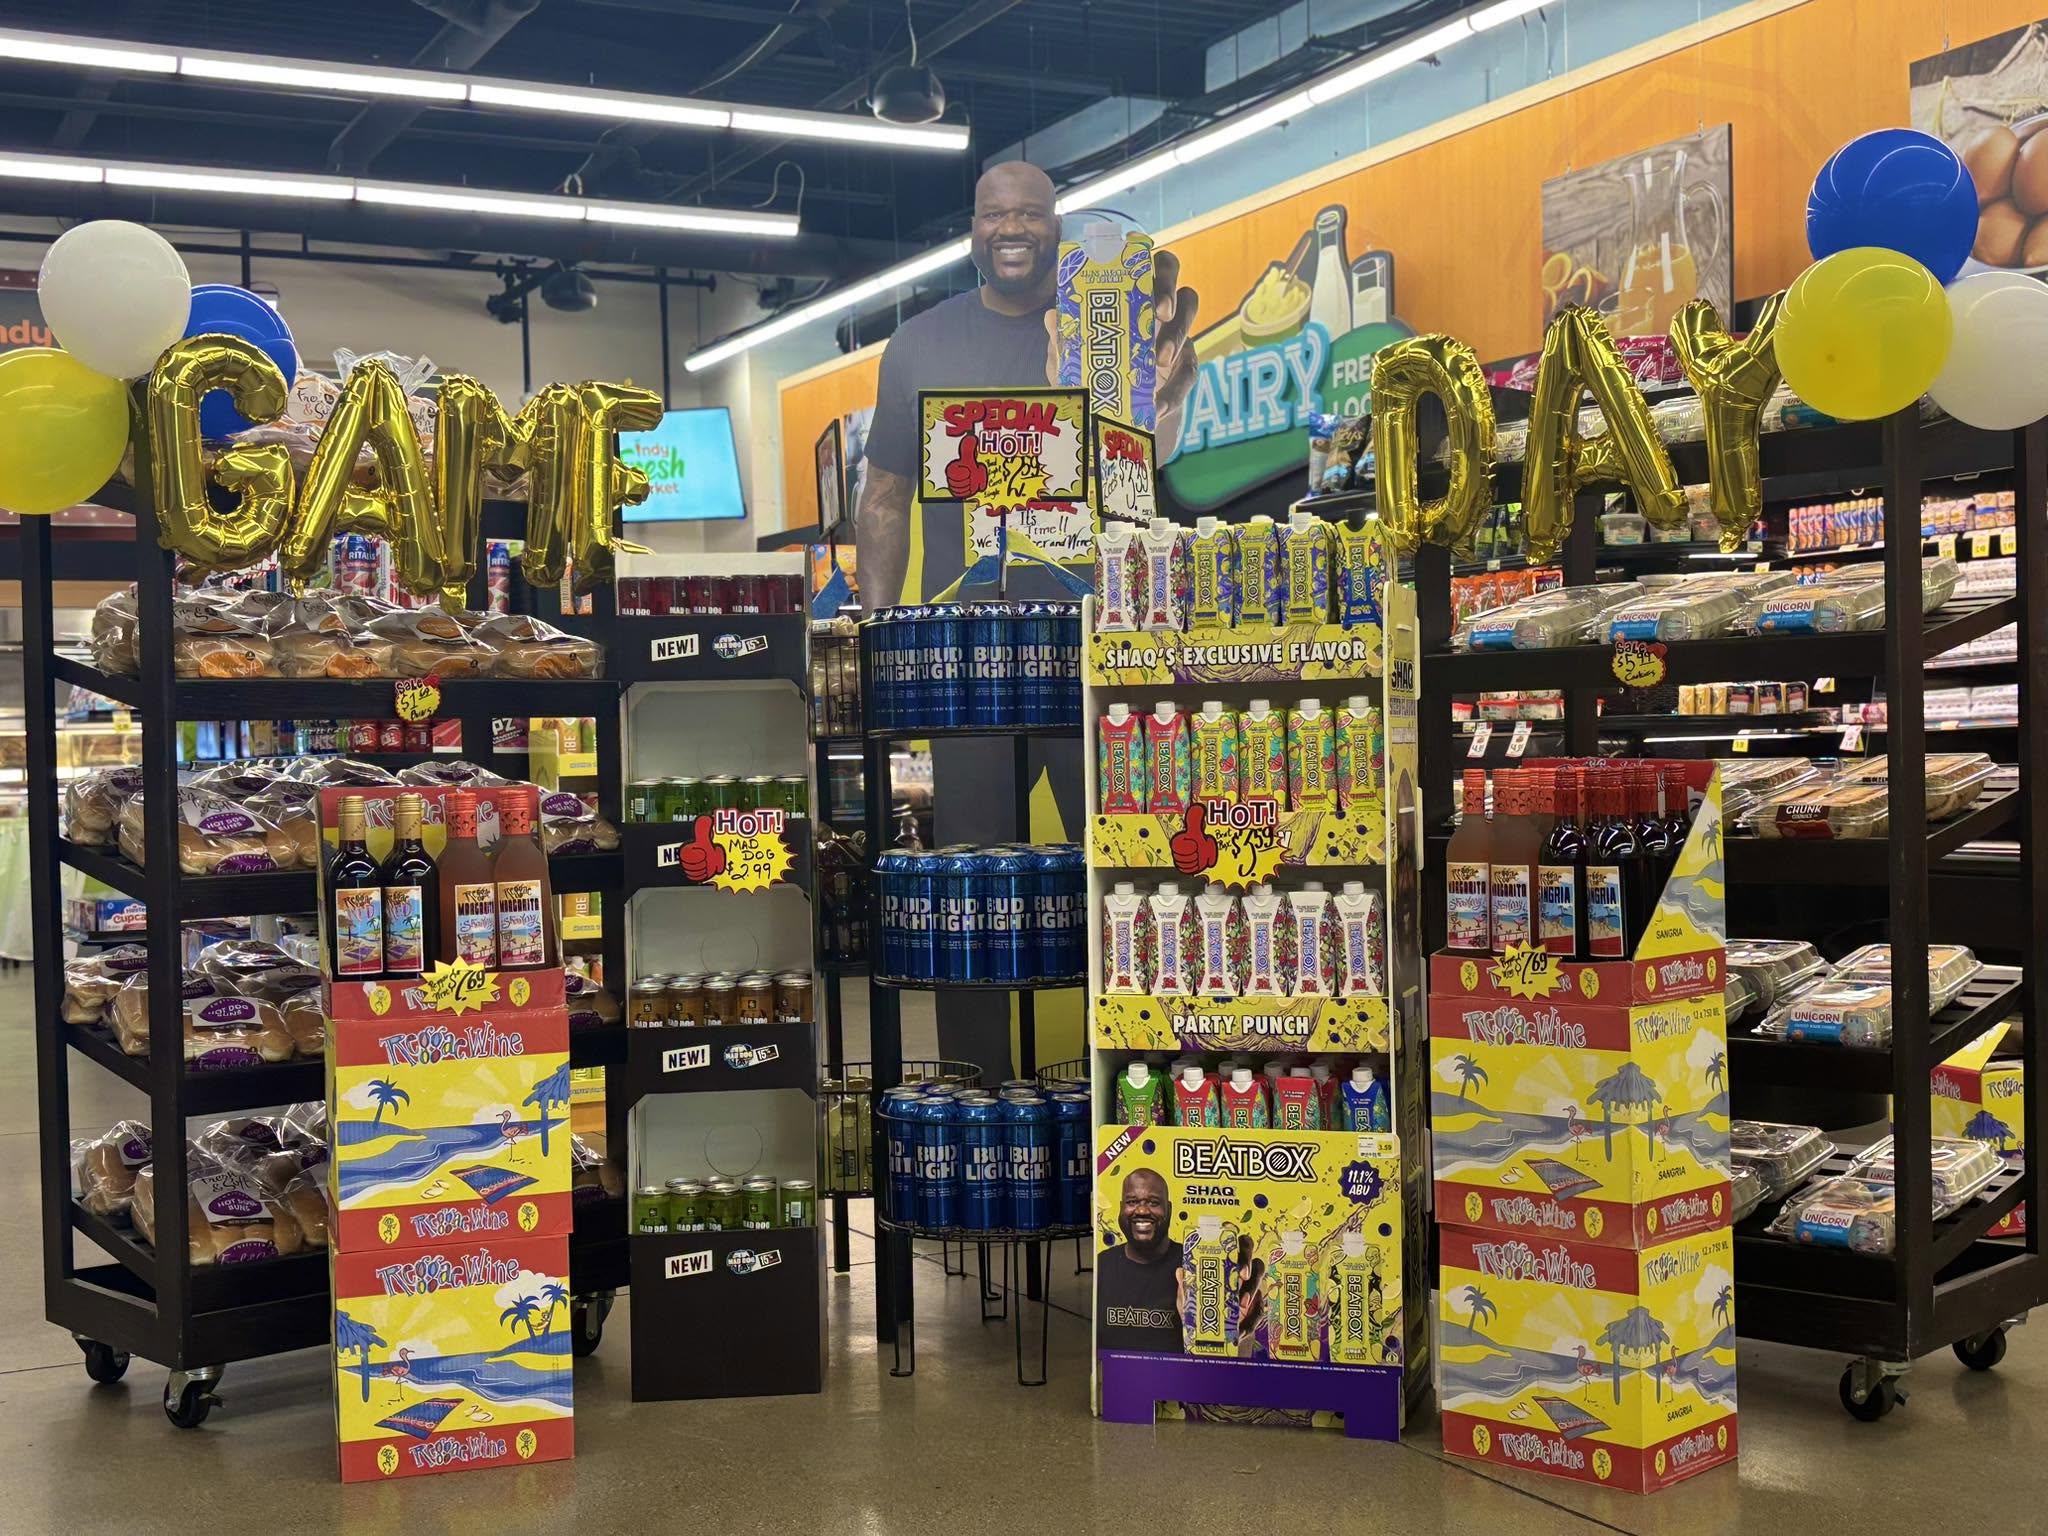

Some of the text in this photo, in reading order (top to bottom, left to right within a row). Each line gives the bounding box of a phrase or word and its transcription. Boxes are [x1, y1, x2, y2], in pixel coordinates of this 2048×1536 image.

[0, 320, 53, 347] ndy
[1087, 288, 1124, 418] BEATBOX
[1185, 328, 1323, 446] AIRY
[1333, 357, 1371, 389] FRE
[944, 400, 1061, 437] SPECIAL
[1372, 293, 1786, 562] DAY
[979, 431, 1043, 457] HOT!
[1020, 510, 1037, 526] It's
[976, 537, 992, 548] We
[1200, 552, 1213, 607] BEATBOX
[1246, 549, 1259, 606] BEATBOX
[1616, 612, 1658, 621] UNICORN
[1766, 601, 1811, 612] UNICORN
[1474, 621, 1515, 631] UNICORN
[657, 637, 694, 658] NEW!
[974, 646, 1013, 663] BUD
[1106, 639, 1367, 669] SHAQ'S EXCLUSIVE FLAVOR
[1616, 641, 1645, 655] Sale
[397, 677, 423, 694] Sale
[1111, 741, 1125, 793] BEATBOX
[1158, 740, 1171, 792] BEATBOX
[716, 809, 784, 837] HOT!
[1208, 799, 1277, 828] HOT!
[1786, 804, 1822, 815] CHUNK
[729, 838, 758, 853] MAD
[743, 849, 775, 861] DOG
[1656, 928, 1683, 940] SANGRIA
[1173, 1015, 1309, 1036] PARTY PUNCH
[1462, 1006, 1587, 1049] Reggae Wine
[1635, 1007, 1692, 1043] Reggae Wine
[1795, 1012, 1840, 1022] UNICORN
[378, 1021, 524, 1067] Reggae Wine
[669, 1048, 705, 1069] NEW!
[1104, 1132, 1133, 1160] NEW
[1174, 1135, 1319, 1182] BEATBOX
[1348, 1169, 1374, 1184] 11.1%
[1658, 1166, 1686, 1181] SANGRIA
[1182, 1197, 1241, 1207] SIZED FLAVOR
[1186, 1185, 1236, 1196] SHAQ
[470, 1202, 509, 1233] Wine
[1539, 1199, 1577, 1231] Wine
[1805, 1213, 1849, 1227] UNICORN
[376, 1248, 520, 1297] Reggae Wine
[671, 1254, 708, 1275] NEW!
[1471, 1240, 1597, 1289] Reggae Wine
[1644, 1244, 1701, 1287] Reggae Wine
[1199, 1256, 1221, 1336] BEATBOX
[1285, 1272, 1300, 1339] BEATBOX
[1346, 1273, 1363, 1342] BEATBOX
[1106, 1305, 1175, 1329] BEATBOX
[1666, 1405, 1693, 1423] SANGRIA
[468, 1431, 507, 1460] Wine
[1547, 1438, 1585, 1470] Wine
